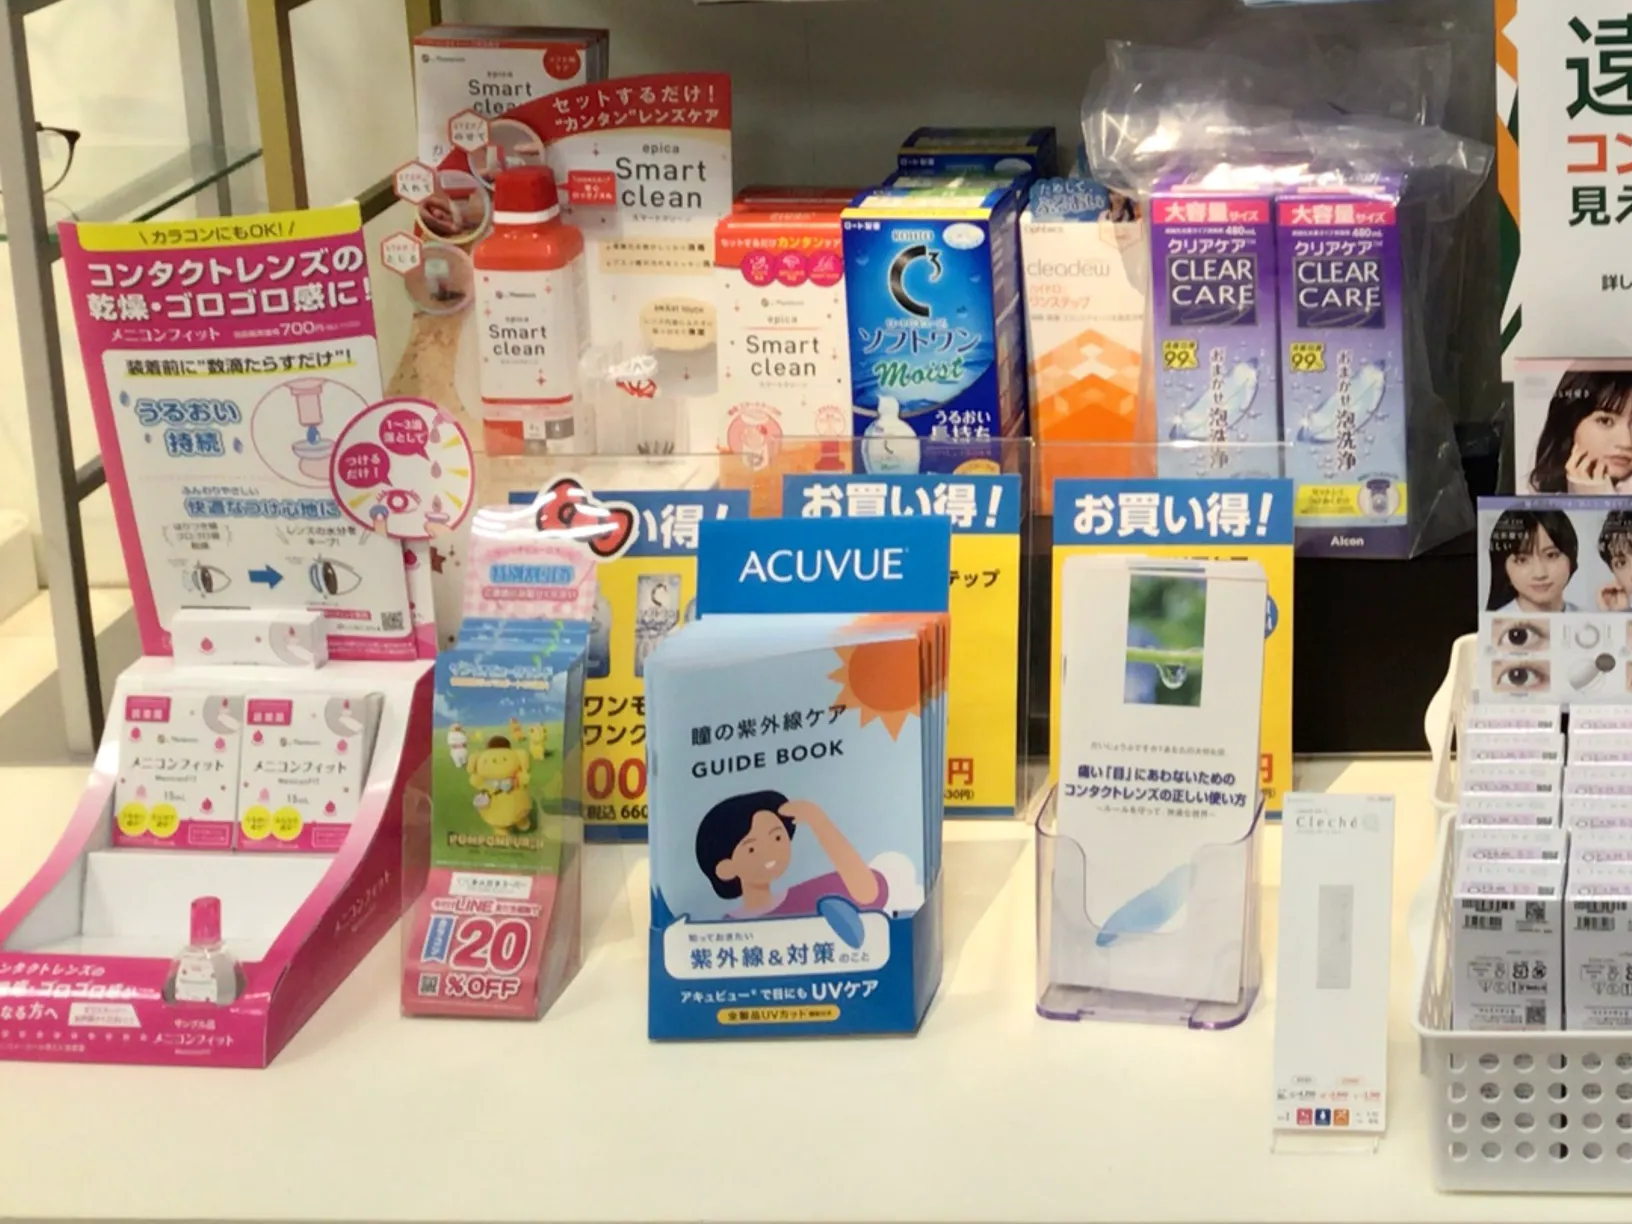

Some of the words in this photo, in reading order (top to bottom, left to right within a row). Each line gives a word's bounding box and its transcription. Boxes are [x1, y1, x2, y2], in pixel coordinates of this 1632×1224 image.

[467, 78, 533, 98] Smart
[552, 85, 716, 115] セットするだけ!
[641, 143, 680, 156] epica
[614, 156, 708, 183] Smart
[620, 185, 703, 210] clean
[1164, 202, 1259, 223] 大容量サイズ
[1291, 203, 1387, 224] 大容量サイズ
[152, 222, 285, 247] カラコンにもOK!
[1167, 239, 1246, 255] クリアケア
[1294, 240, 1373, 256] クリアケア
[88, 245, 365, 289] コンタクトレンズの
[1026, 259, 1111, 278] cleadew
[1170, 258, 1253, 282] CLEAR
[1297, 261, 1380, 284] CLEAR
[87, 281, 374, 323] 乾燥・ゴロゴロ感に!
[1171, 284, 1255, 307] CARE
[1298, 286, 1382, 310] CARE
[767, 313, 799, 326] epica
[110, 326, 221, 343] メニコンフィット
[488, 324, 548, 341] Smart
[859, 327, 981, 356] ソフトワン
[492, 340, 546, 358] clean
[745, 334, 821, 356] Smart
[750, 356, 818, 378] clean
[872, 355, 964, 388] Moist
[135, 399, 241, 427] うるおい
[935, 410, 992, 425] うるおい
[1209, 346, 1230, 470] おまかせ泡洗浄
[1336, 348, 1358, 471] おまかせ泡洗浄
[166, 430, 224, 457] 持続
[344, 453, 381, 467] つける
[185, 498, 343, 520] 快適なつけ心地に
[802, 483, 1004, 530] お買い得!
[1073, 492, 1274, 539] お買い得!
[1330, 535, 1365, 547] Alcon
[738, 548, 905, 583] ACUVUE
[690, 703, 848, 748] 瞳の紫外線ケア
[131, 757, 225, 772] メニコンフィット
[253, 759, 348, 775] メニコンフィット
[690, 749, 767, 780] GUIDE
[776, 738, 845, 767] BOOK
[1077, 763, 1236, 787] 痛い「目」にあわないための
[1064, 783, 1248, 809] コンタクトレンズの正しい使い方
[450, 916, 532, 975] 20
[445, 974, 521, 999] %OFF
[680, 989, 750, 1004] アキュビュー
[760, 987, 808, 1001] で目にも
[811, 979, 880, 1001] UVケア
[153, 1033, 235, 1047] メニコンフィット
